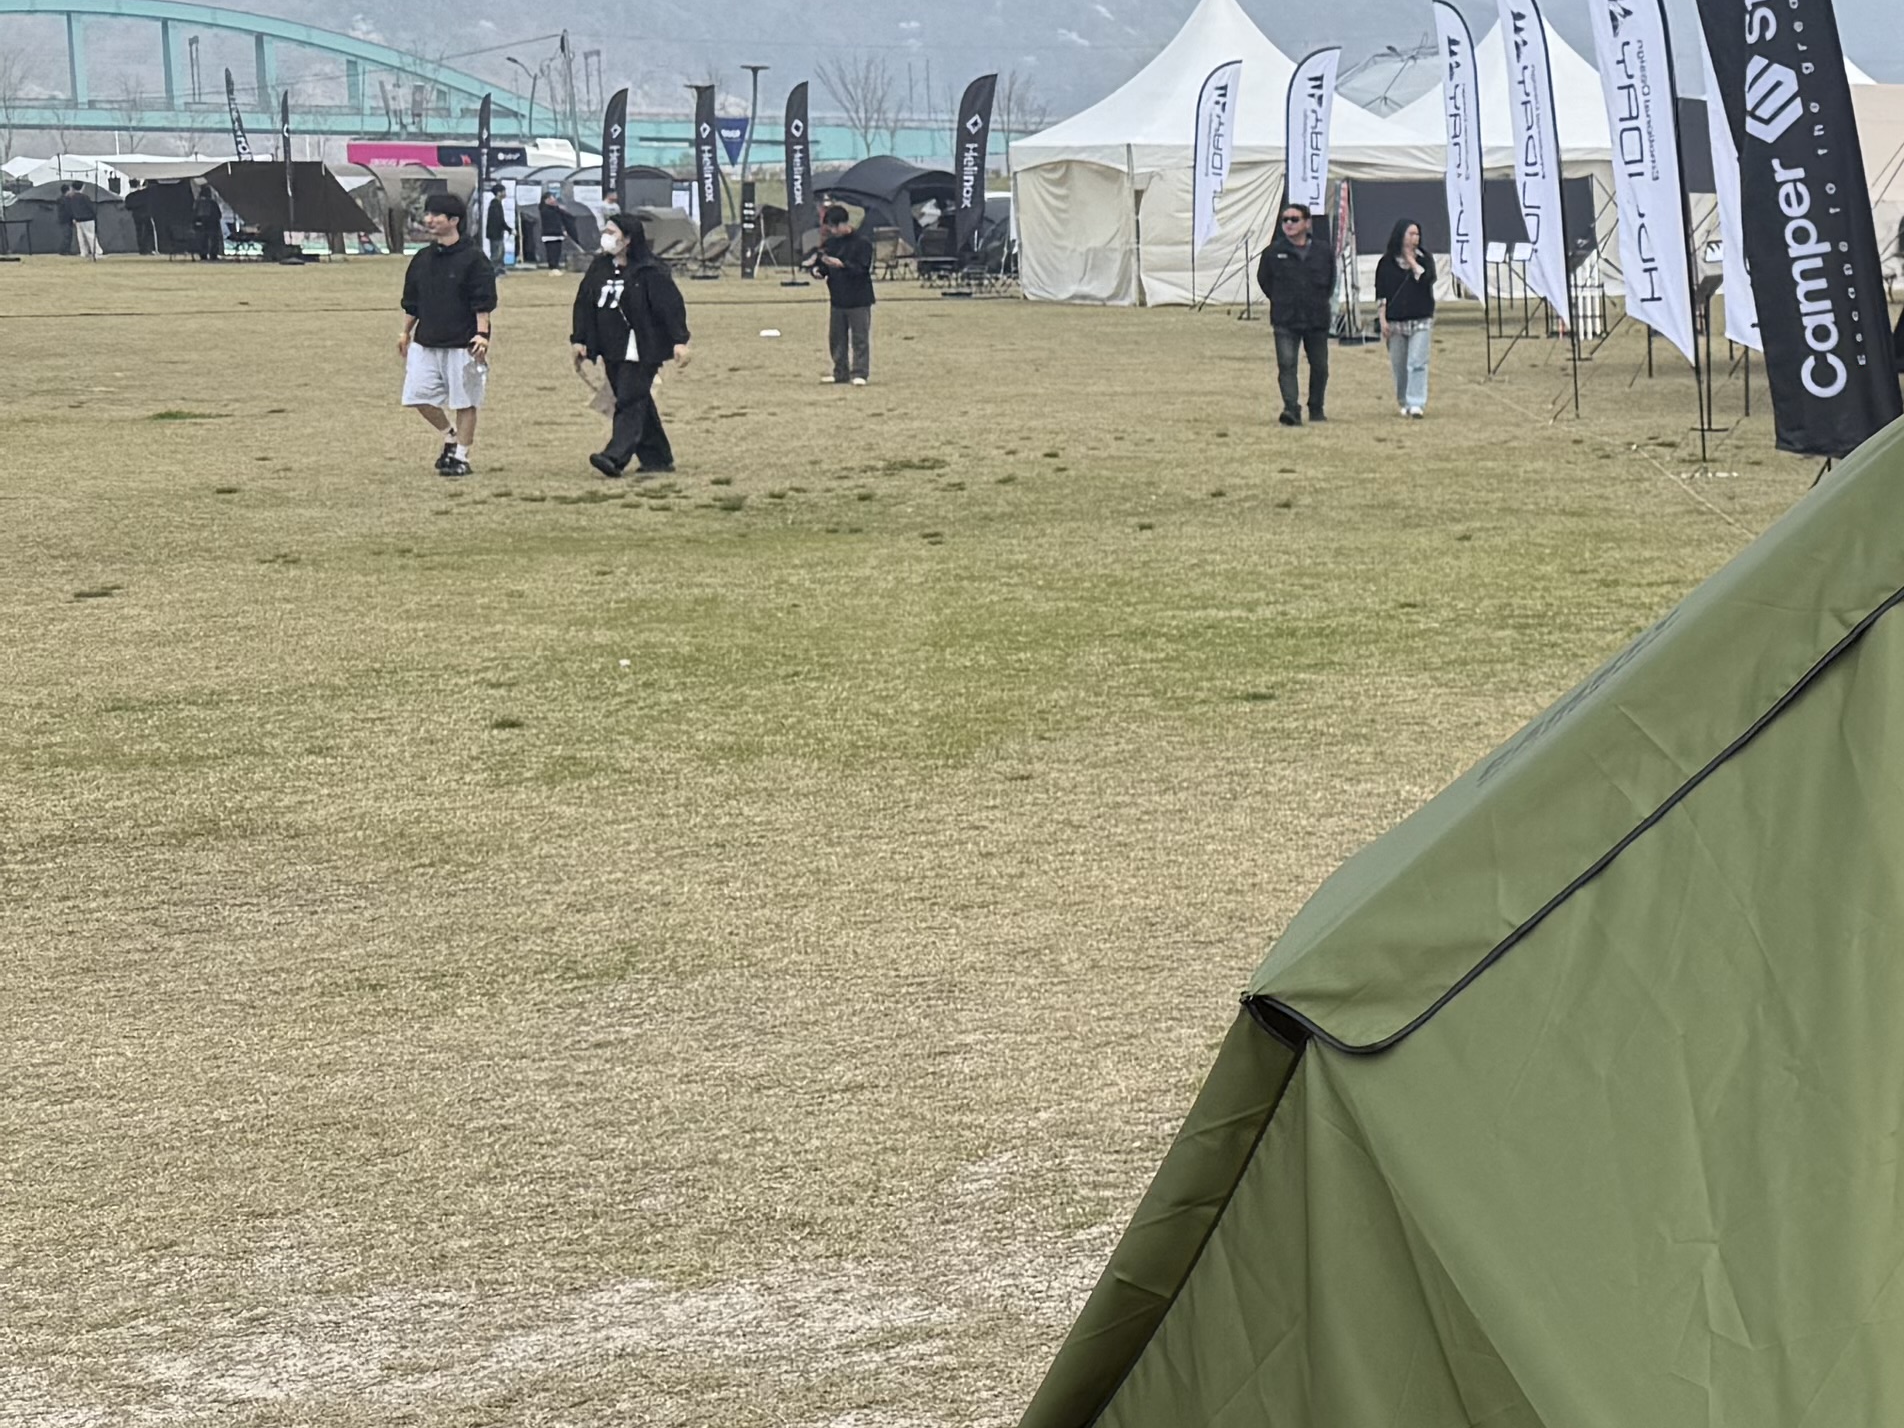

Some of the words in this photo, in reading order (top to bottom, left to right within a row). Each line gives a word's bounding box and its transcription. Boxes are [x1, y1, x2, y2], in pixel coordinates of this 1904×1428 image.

[701, 145, 715, 203] Helinox
[961, 143, 980, 209] Helinox
[1771, 158, 1848, 399] Camper
